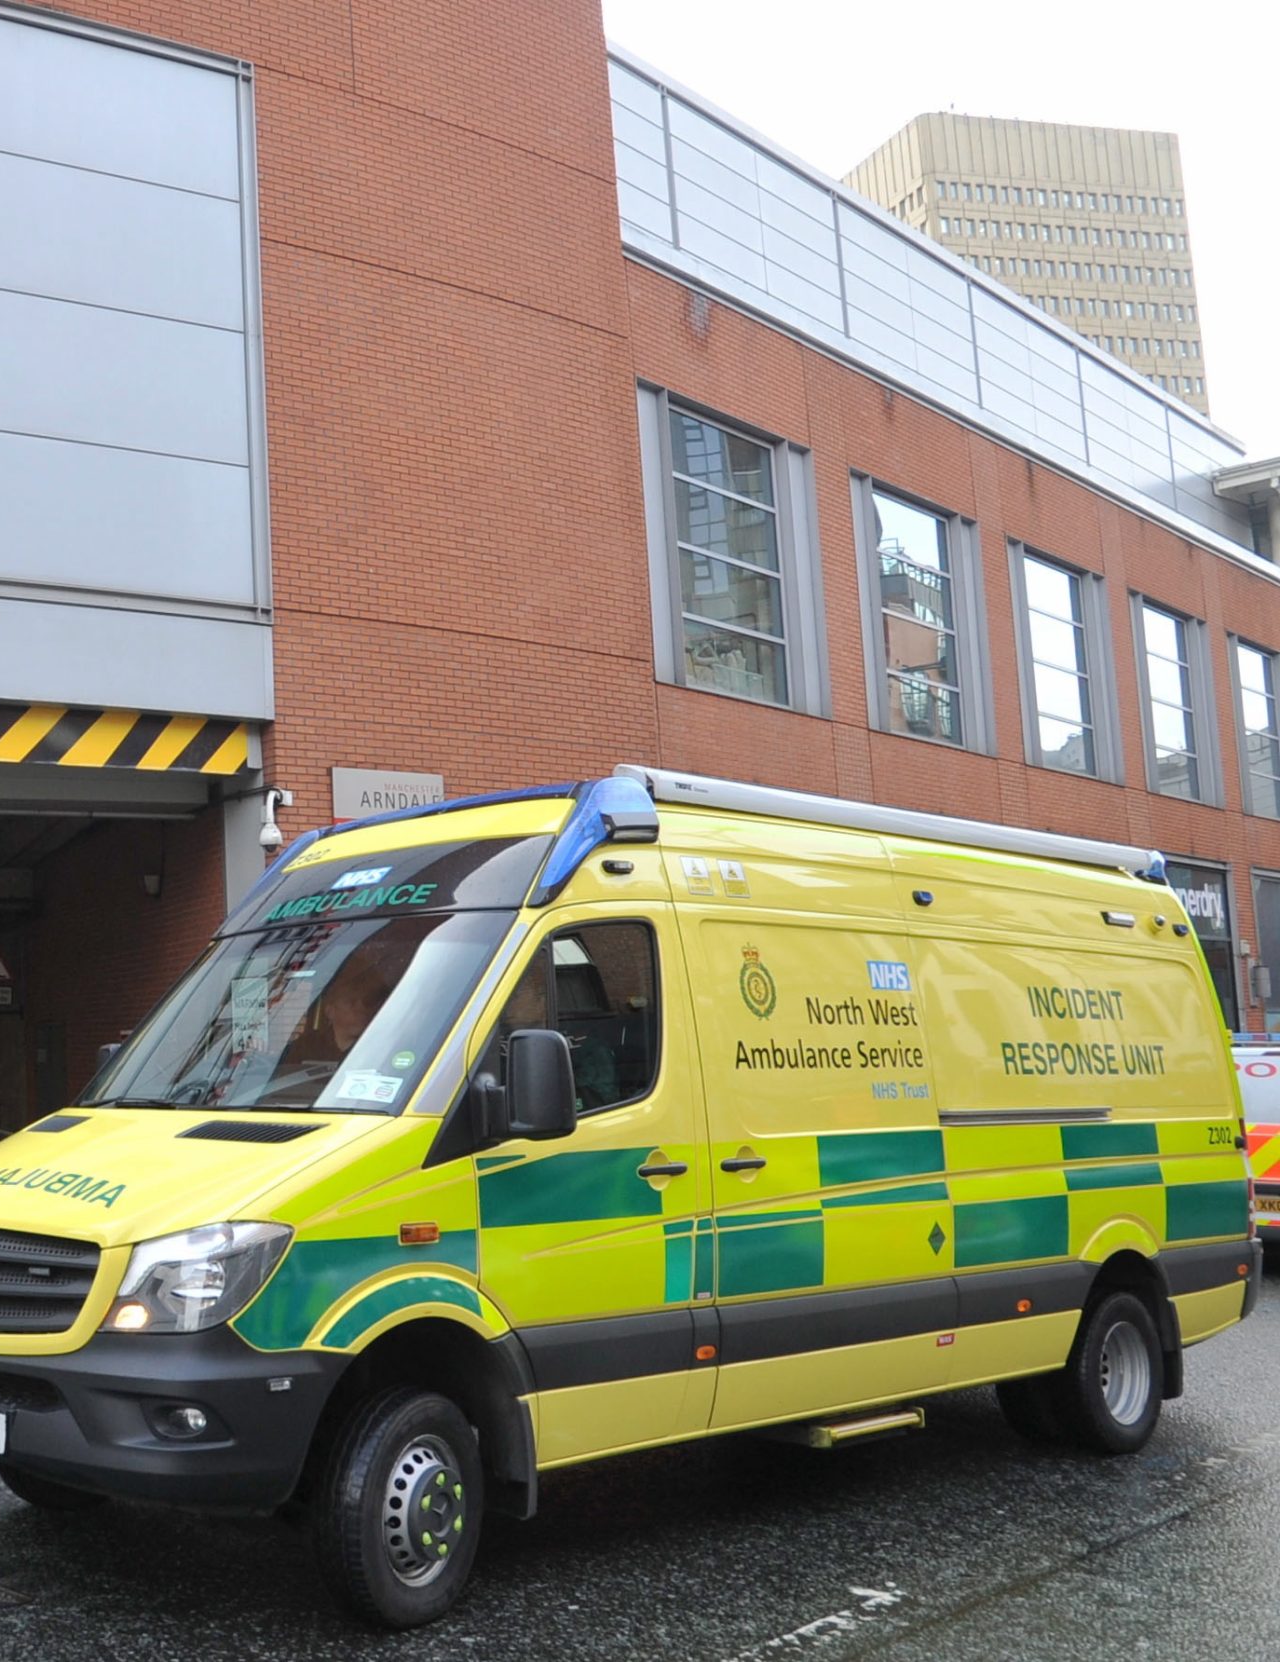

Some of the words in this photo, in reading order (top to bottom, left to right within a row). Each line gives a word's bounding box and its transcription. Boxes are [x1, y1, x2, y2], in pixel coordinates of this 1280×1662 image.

[383, 783, 440, 794] MANCHESTER
[335, 867, 387, 887] NHS
[260, 883, 438, 923] AMBULANCE
[869, 963, 909, 990] NHS
[805, 996, 865, 1025] North
[867, 998, 918, 1026] West
[1027, 986, 1124, 1020] INCIDENT
[735, 1038, 851, 1070] Ambulance
[857, 1040, 924, 1069] Service
[1001, 1042, 1119, 1076] RESPONSE
[1121, 1044, 1166, 1075] UNIT
[871, 1082, 899, 1099] NHS
[900, 1082, 929, 1099] Trust
[1208, 1126, 1232, 1145] Z302
